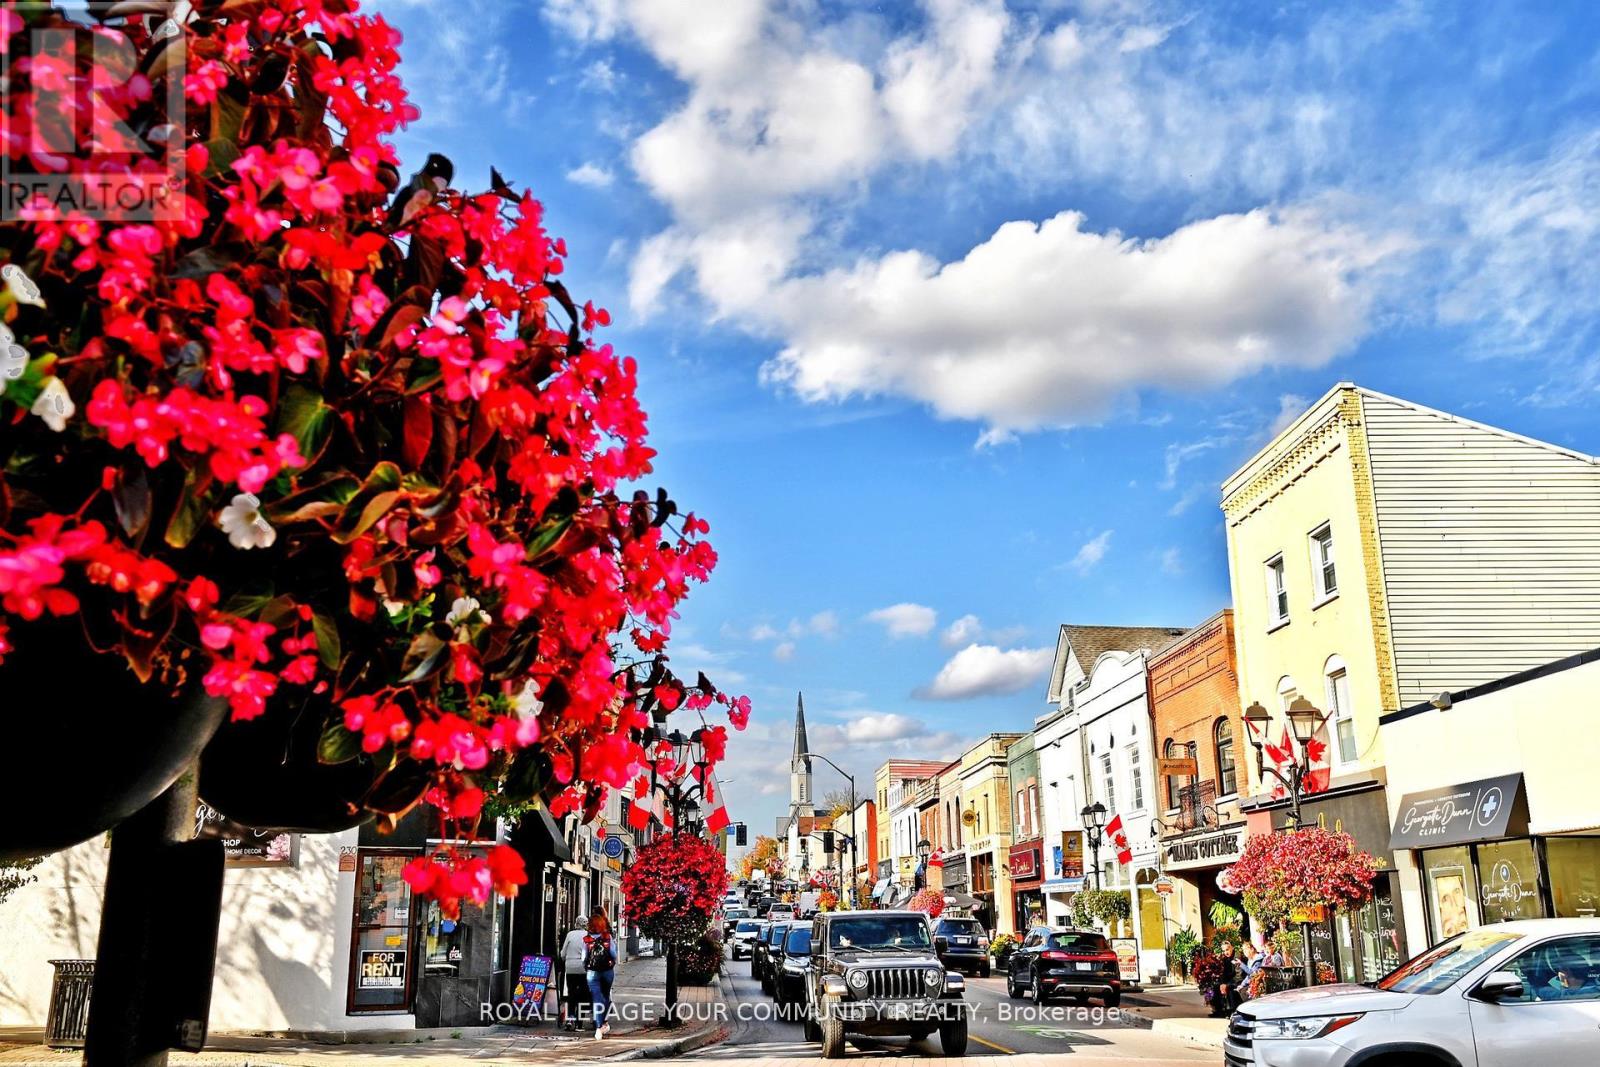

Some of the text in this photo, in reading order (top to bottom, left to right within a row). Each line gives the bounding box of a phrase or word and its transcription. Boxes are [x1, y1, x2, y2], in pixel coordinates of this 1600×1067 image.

[1401, 801, 1472, 834] Georgette Dunn
[1419, 826, 1447, 836] CLINIC
[340, 846, 357, 855] 230
[1199, 835, 1239, 858] COTTAGE
[373, 953, 395, 962] FOR
[361, 963, 403, 977] RENT
